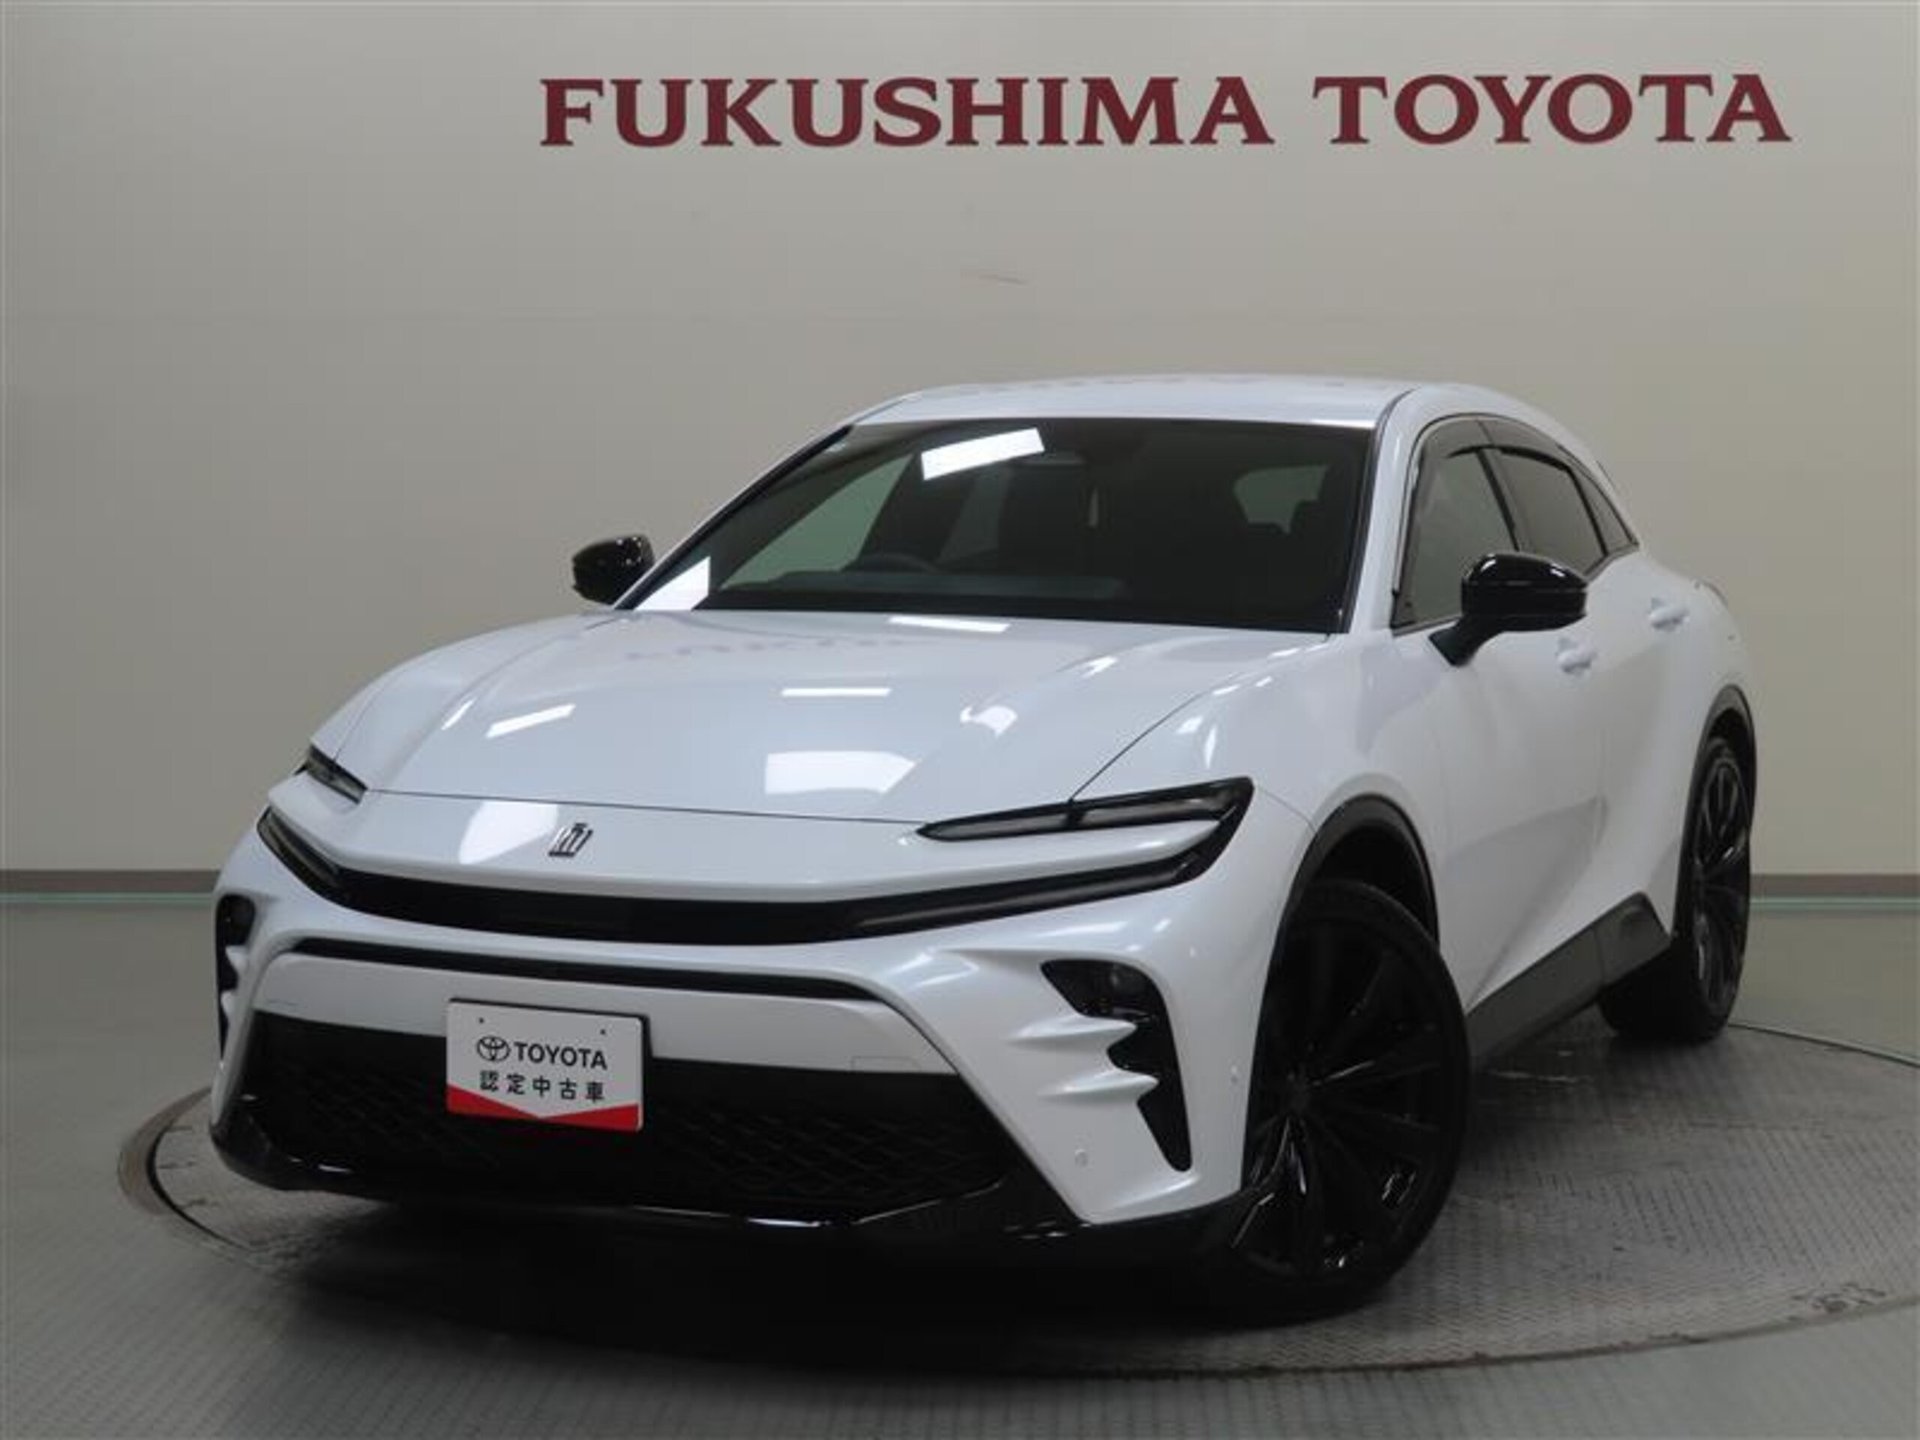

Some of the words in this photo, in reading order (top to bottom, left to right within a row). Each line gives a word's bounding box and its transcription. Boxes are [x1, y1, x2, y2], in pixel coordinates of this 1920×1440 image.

[540, 77, 1274, 147] FUKUSHIMA
[1313, 74, 1791, 144] TOYOTA
[514, 1041, 608, 1070] TOYOTA
[480, 1070, 605, 1102] 認定中古車
